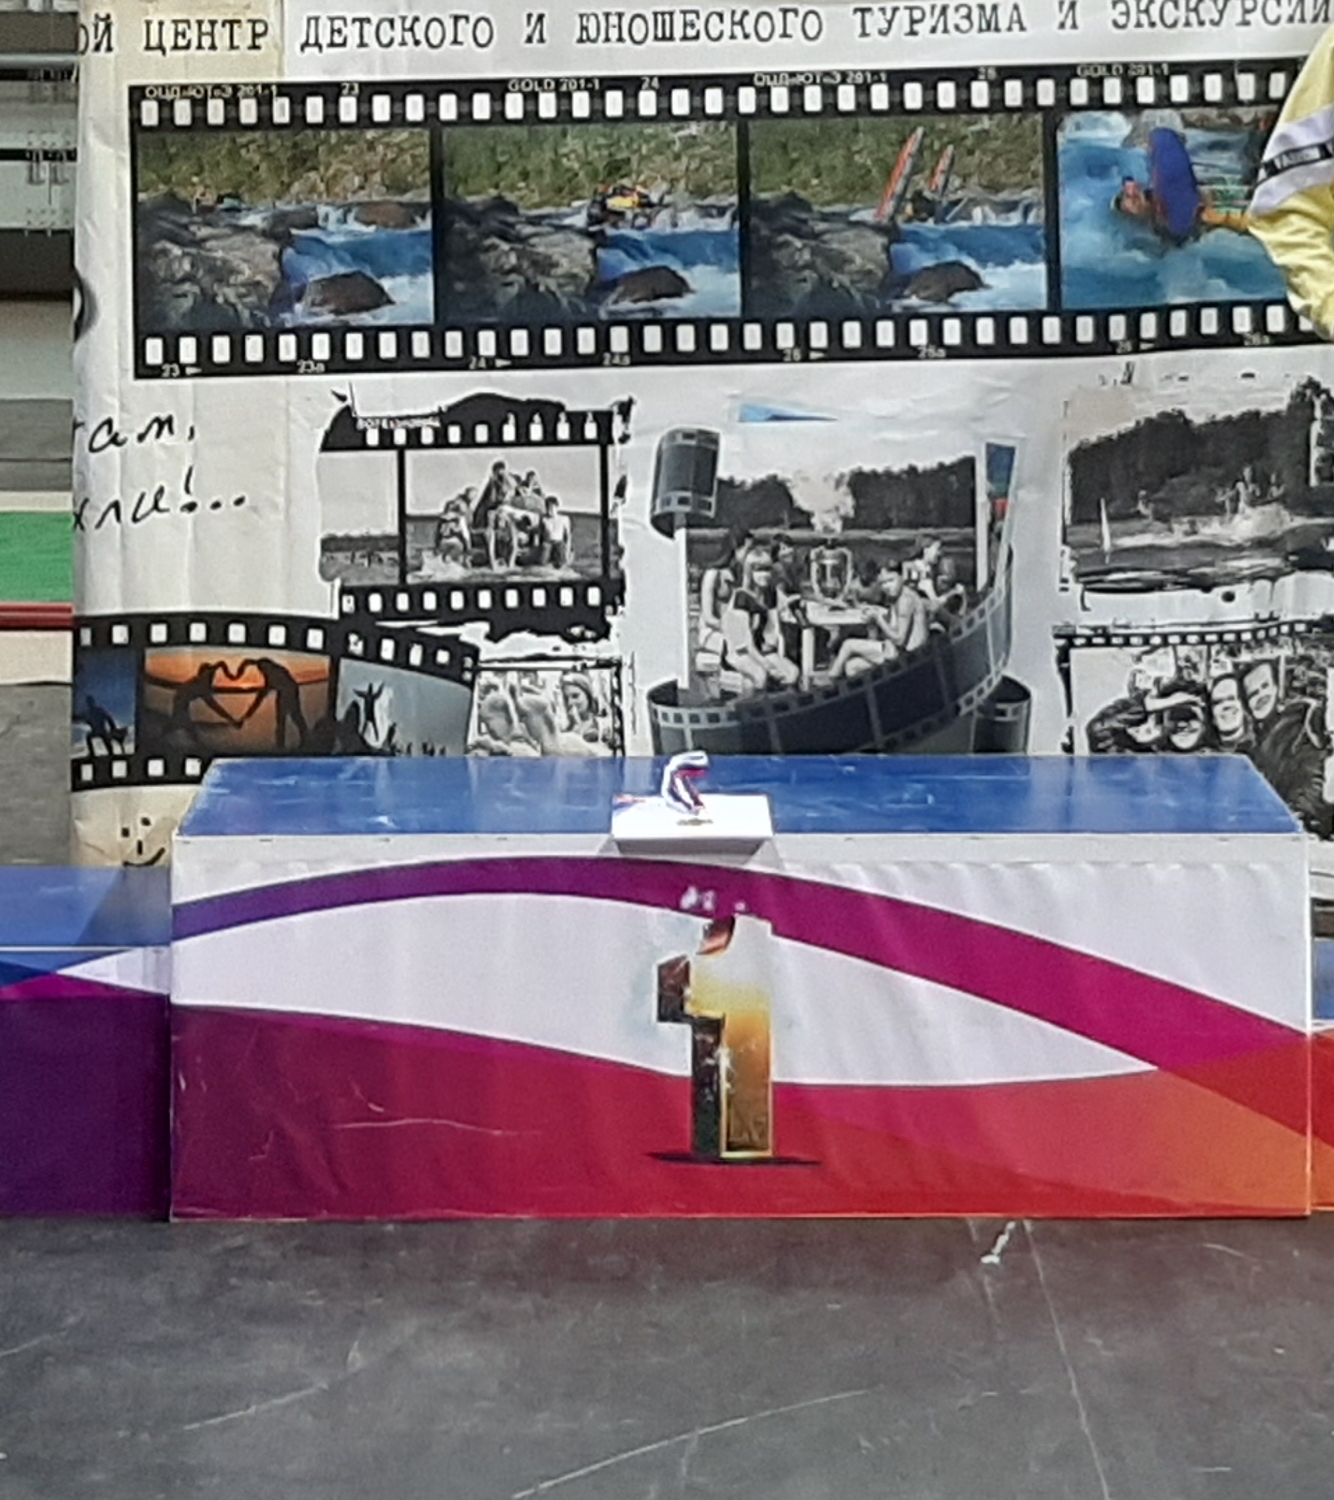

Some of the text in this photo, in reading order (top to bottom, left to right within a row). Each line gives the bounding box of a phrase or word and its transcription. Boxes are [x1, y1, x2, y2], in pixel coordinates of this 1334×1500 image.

[143, 15, 270, 57] ЦЕНТР
[299, 12, 495, 54] ДЕТСКОГО
[523, 13, 549, 45] И
[575, 6, 824, 47] ЮНОШЕСКОГО
[1057, 0, 1080, 31] И
[507, 78, 556, 92] GOLD
[641, 76, 660, 89] 24
[655, 914, 774, 1160] 1
